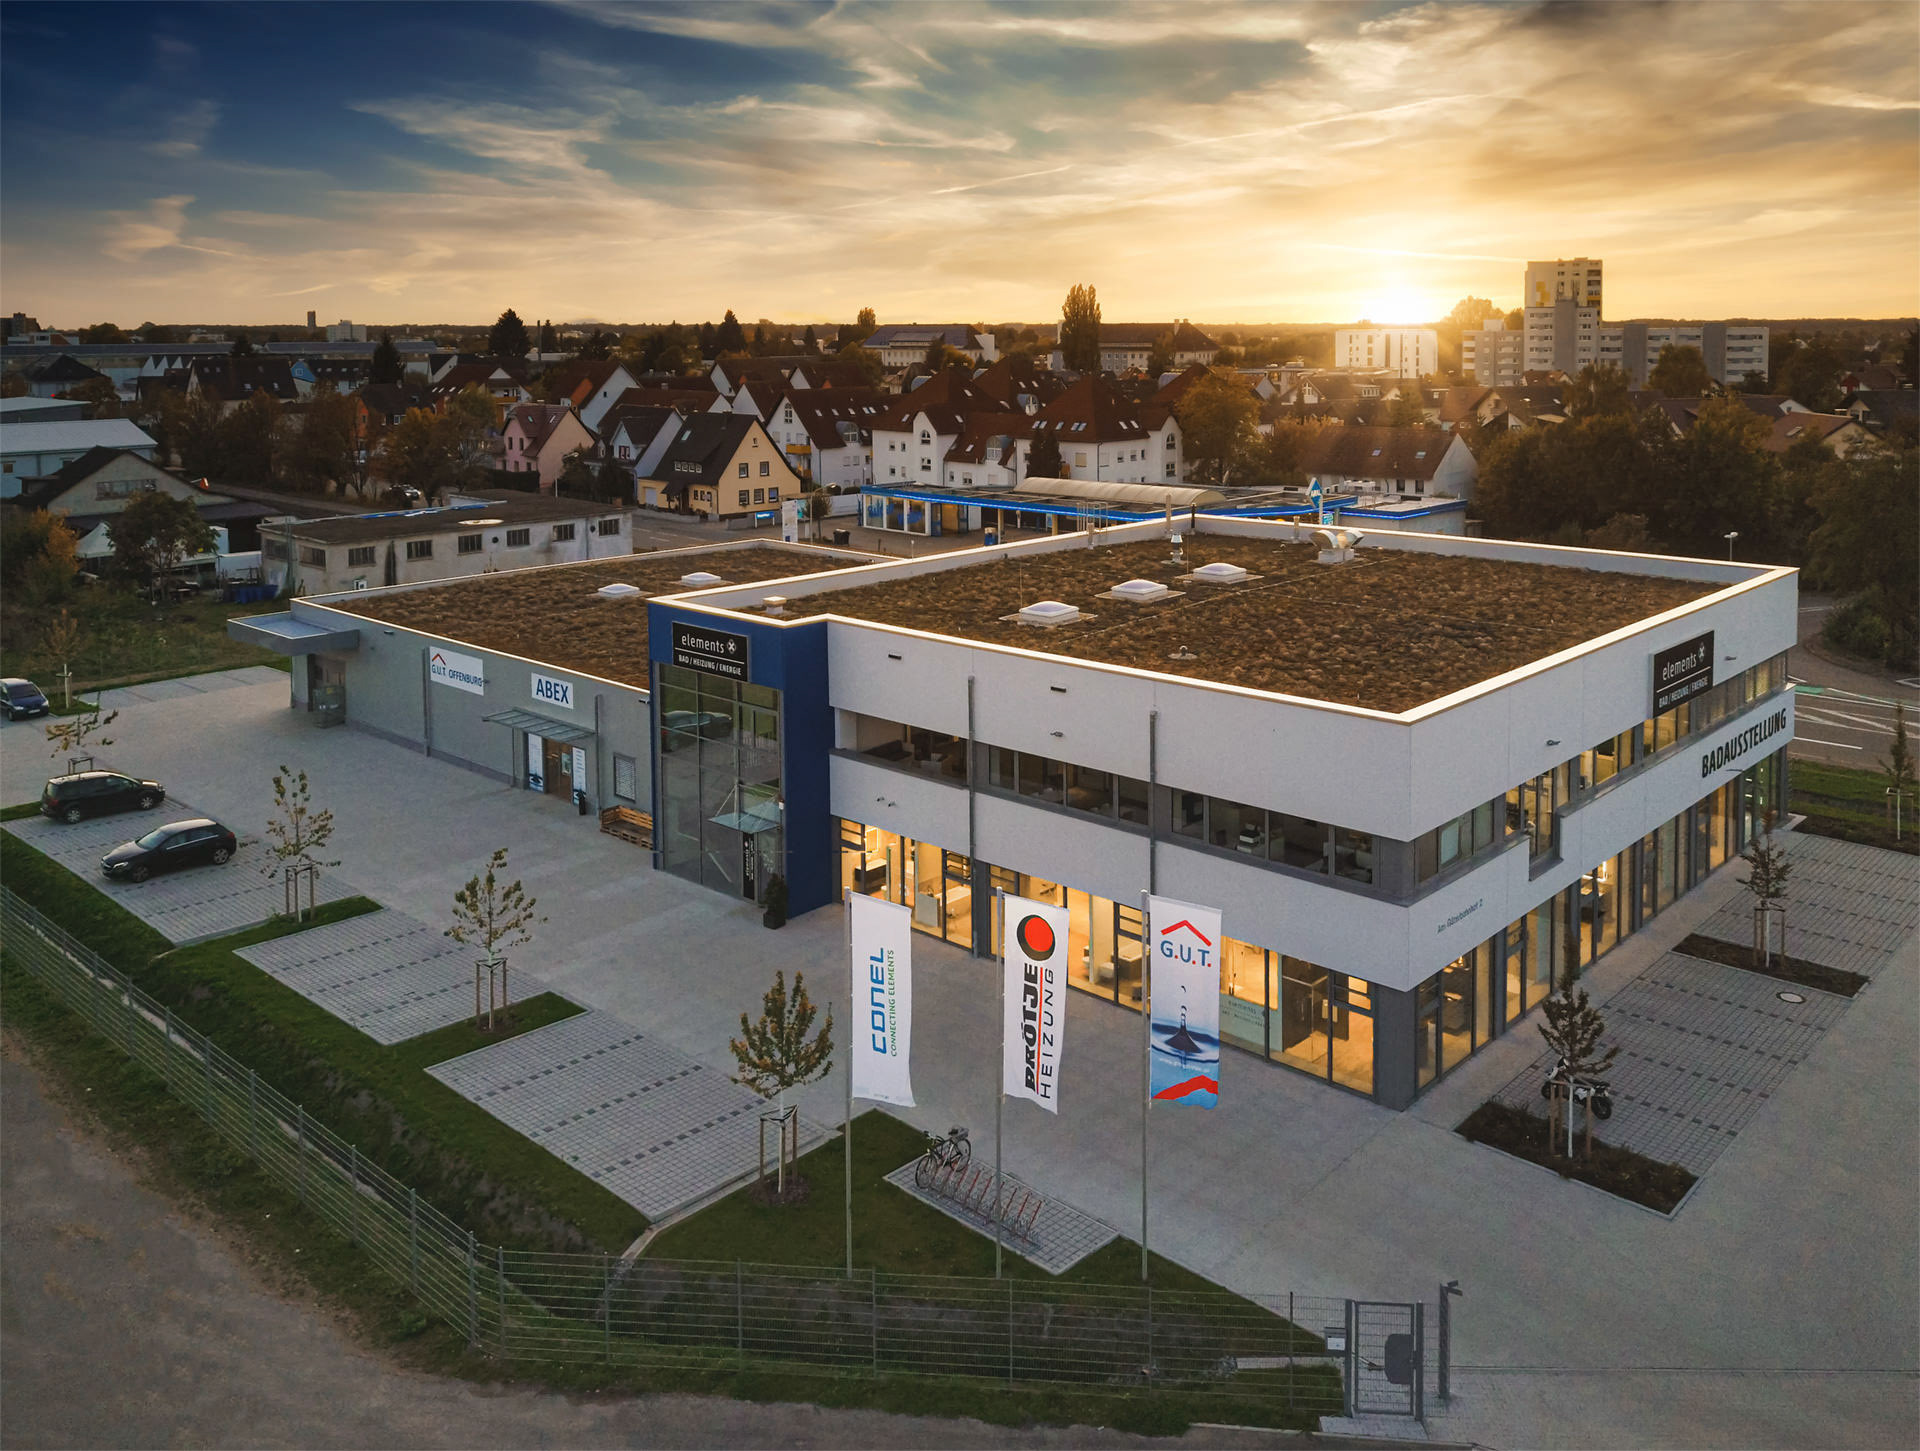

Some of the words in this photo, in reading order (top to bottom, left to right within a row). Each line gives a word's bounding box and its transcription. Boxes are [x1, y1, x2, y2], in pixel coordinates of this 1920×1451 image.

[681, 633, 725, 654] elements
[448, 668, 483, 688] OFFENBURG
[678, 654, 689, 663] BAD
[693, 657, 715, 670] HEIZUNG
[720, 664, 741, 675] ENERGIE
[1662, 652, 1697, 681] elements
[535, 678, 570, 705] ABEX
[1658, 695, 1669, 709] BAD
[1671, 685, 1689, 702] HEIZUNG
[1701, 707, 1787, 779] BADAUSSTELLUNG
[1160, 939, 1212, 969] G.U.T.
[887, 950, 896, 996] ELEMENTS
[888, 998, 897, 1057] CONNECTING
[1021, 962, 1039, 1093] BRÖTJE
[1040, 967, 1055, 1100] HEIZUNG
